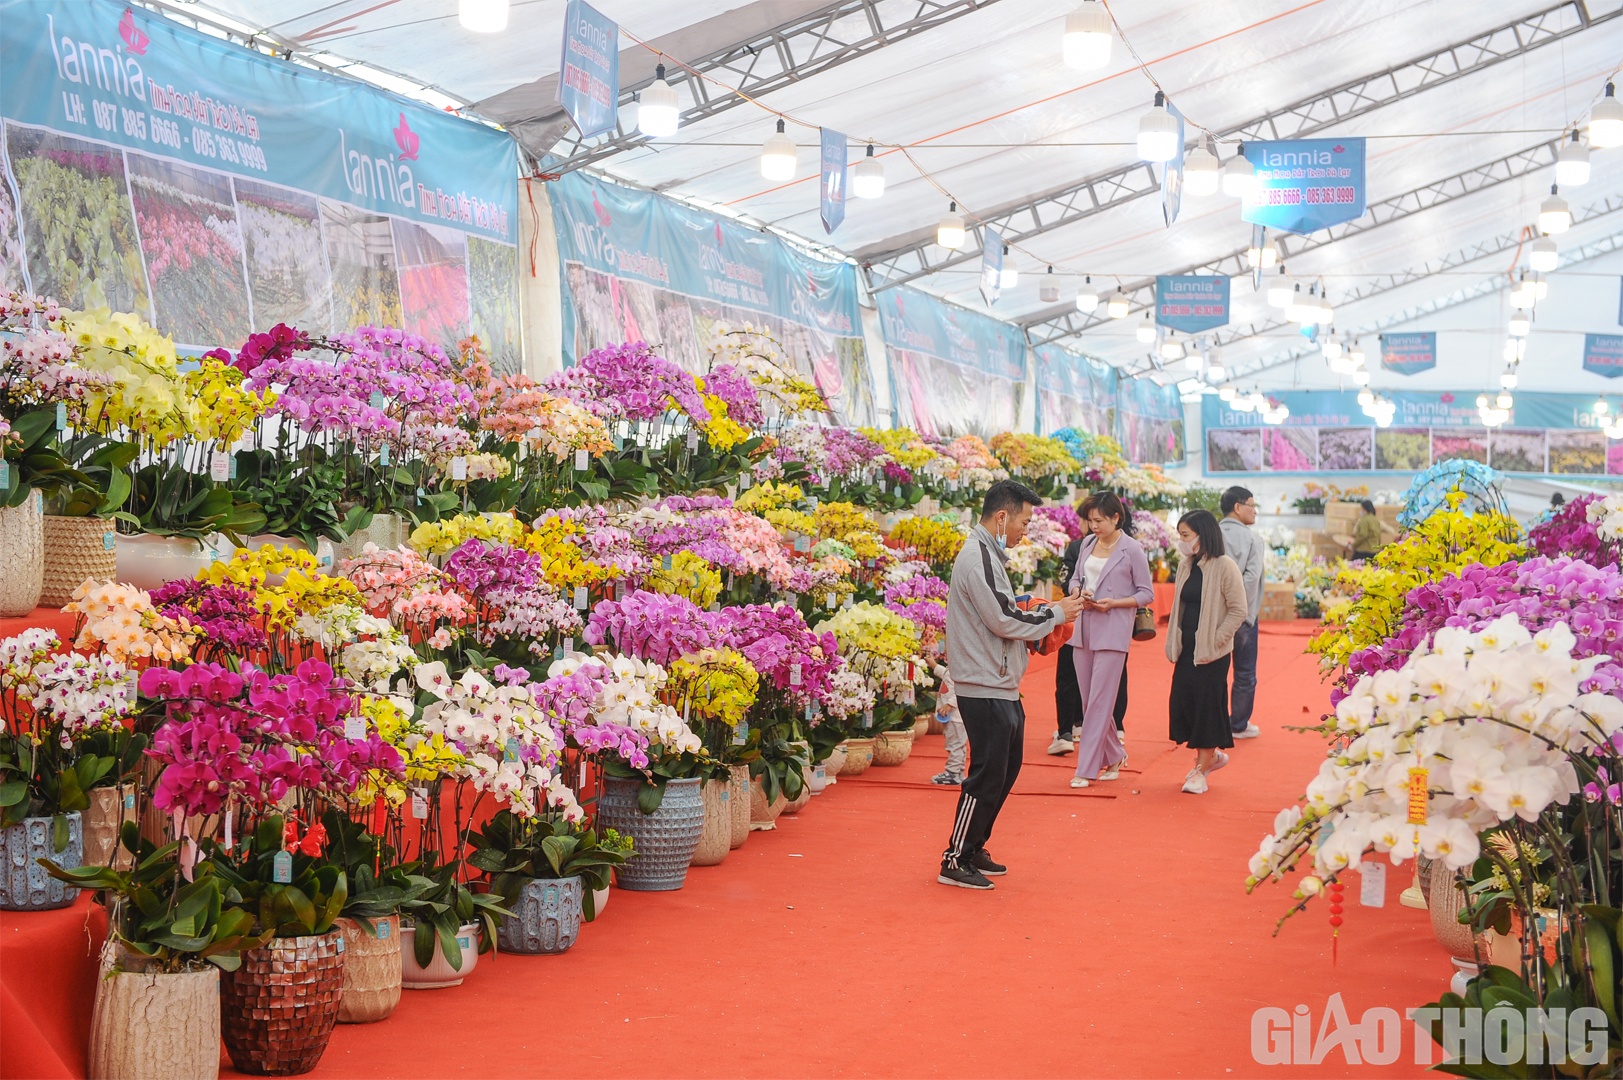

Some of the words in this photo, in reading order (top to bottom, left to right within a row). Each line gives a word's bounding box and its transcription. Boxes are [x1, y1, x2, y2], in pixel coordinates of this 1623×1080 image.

[576, 10, 607, 51] lannia
[46, 13, 147, 102] lannia
[62, 90, 87, 125] LH:
[92, 98, 117, 133] 087
[122, 106, 147, 141] 885
[150, 115, 182, 150] 6666
[192, 126, 217, 158] 085
[215, 134, 240, 164] 363
[237, 140, 268, 172] 9999
[338, 128, 416, 208] lannia
[1262, 149, 1332, 167] lannia
[1283, 187, 1301, 206] 6666
[1306, 186, 1321, 205] 085
[1321, 186, 1335, 205] 363
[1336, 185, 1355, 205] 9999
[1169, 280, 1214, 292] lannia
[1402, 399, 1449, 416] lannia
